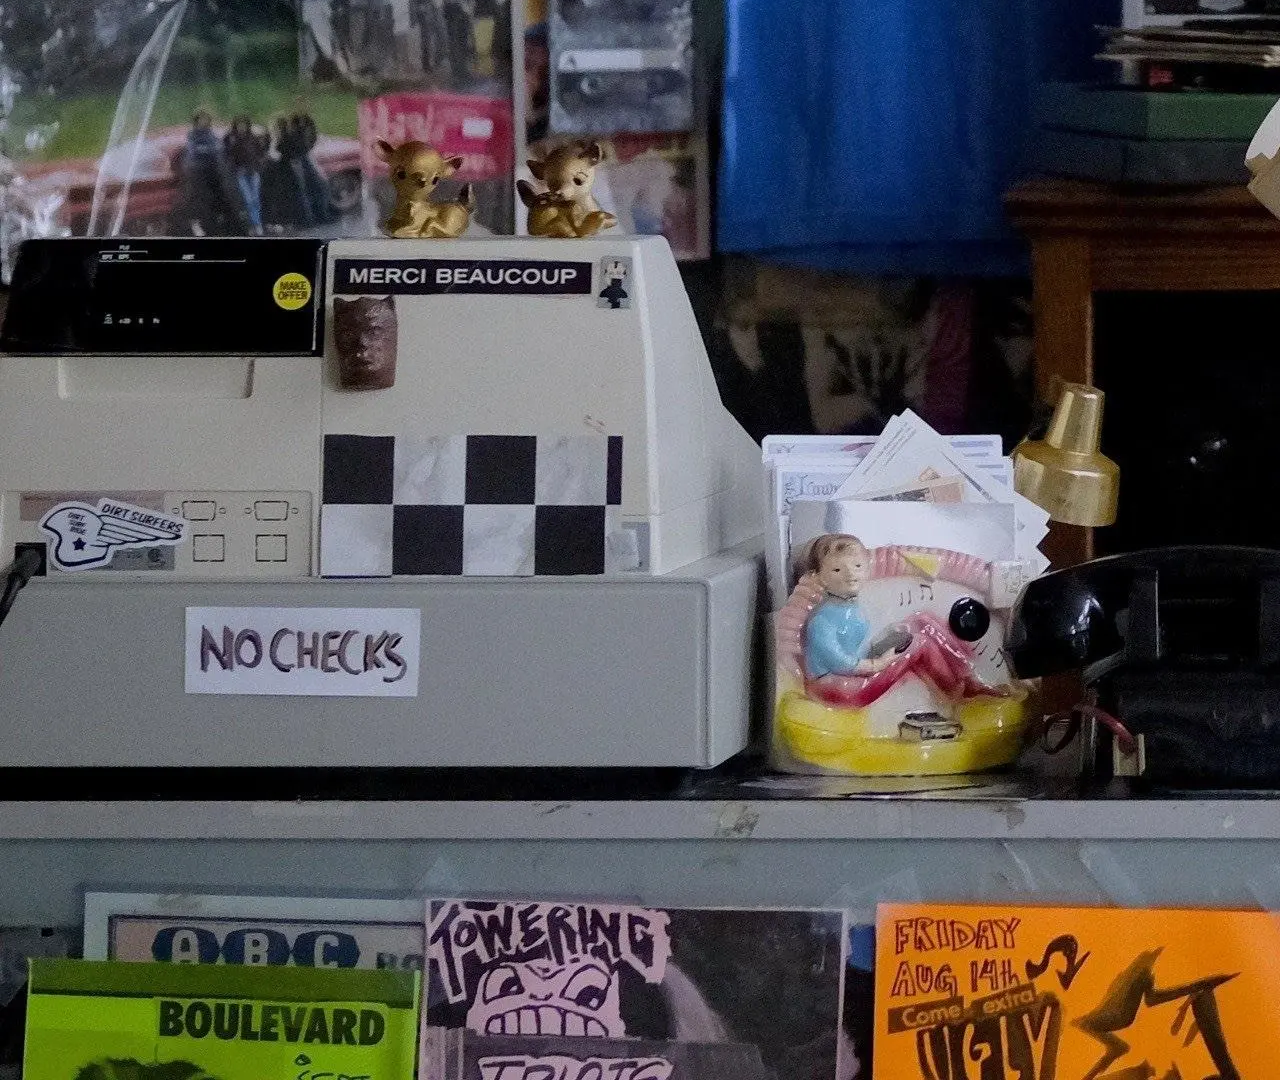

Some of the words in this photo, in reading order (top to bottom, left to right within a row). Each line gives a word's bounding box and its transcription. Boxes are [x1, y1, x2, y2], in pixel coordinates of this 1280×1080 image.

[279, 281, 306, 291] MAKE
[348, 269, 427, 286] MERCI
[435, 269, 578, 286] BEAUCOUP
[277, 291, 308, 301] OFFER
[101, 503, 129, 517] DIRT
[132, 511, 183, 533] SURFERS
[200, 625, 263, 673] NO
[270, 631, 407, 682] CHECKS
[430, 903, 655, 998] TOWERING
[894, 917, 1021, 954] FRIDAY
[891, 960, 958, 997] AUG
[970, 958, 1019, 993] 14th
[983, 987, 1035, 1014] extra
[159, 1000, 386, 1046] BOULEVARD
[902, 1005, 961, 1028] Come
